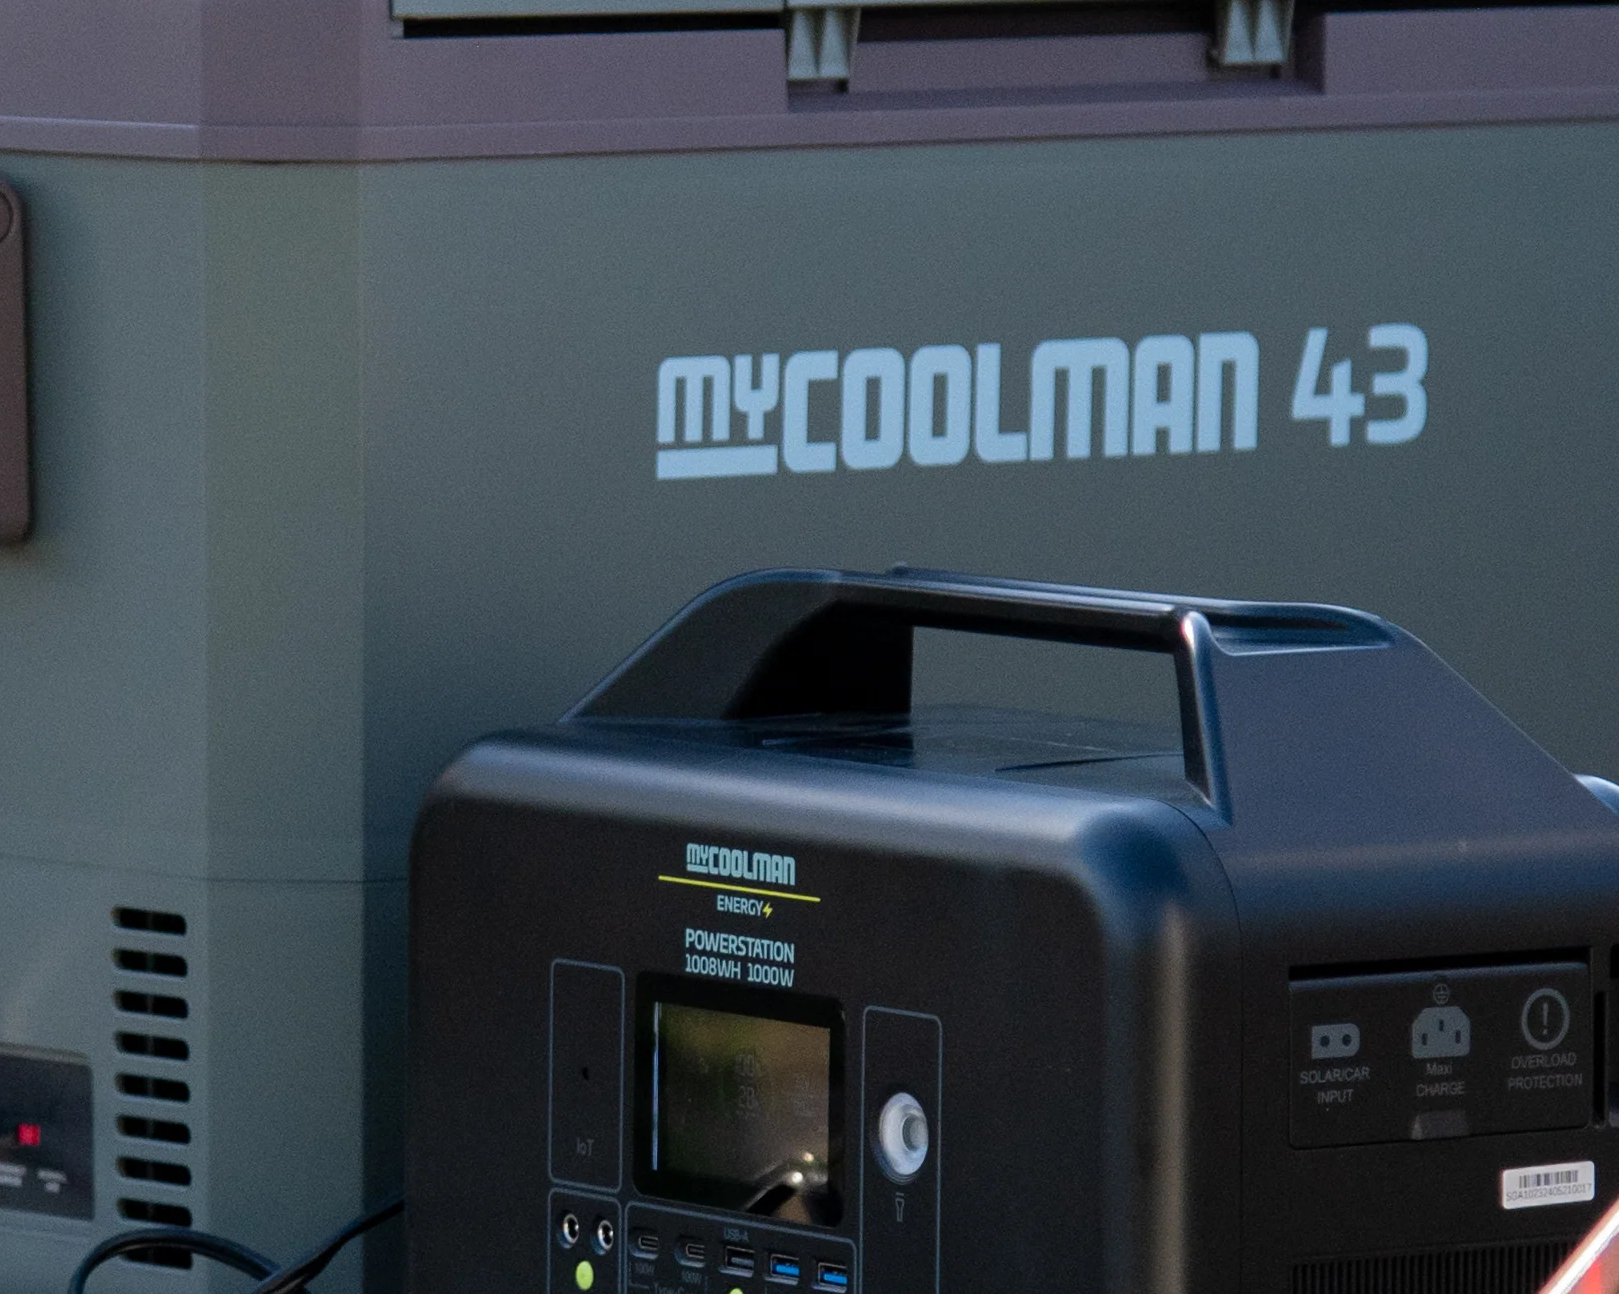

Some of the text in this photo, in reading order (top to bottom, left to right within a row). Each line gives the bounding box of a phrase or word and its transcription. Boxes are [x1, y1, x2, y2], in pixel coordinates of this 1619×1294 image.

[656, 321, 1429, 478] MYCOOLMAN 43
[686, 842, 796, 886] MYCOOLMAN
[716, 895, 763, 917] ENERGY
[685, 928, 795, 964] POWERSTATION
[685, 953, 795, 988] 1008WH 1000W
[1425, 1061, 1453, 1077] Maxi
[1510, 1052, 1577, 1071] OVERLOAD
[1299, 1065, 1371, 1085] SOLAR/CAR
[1507, 1072, 1583, 1091] PROTECTION
[1317, 1087, 1355, 1104] INPUT
[1416, 1080, 1466, 1098] CHARGE
